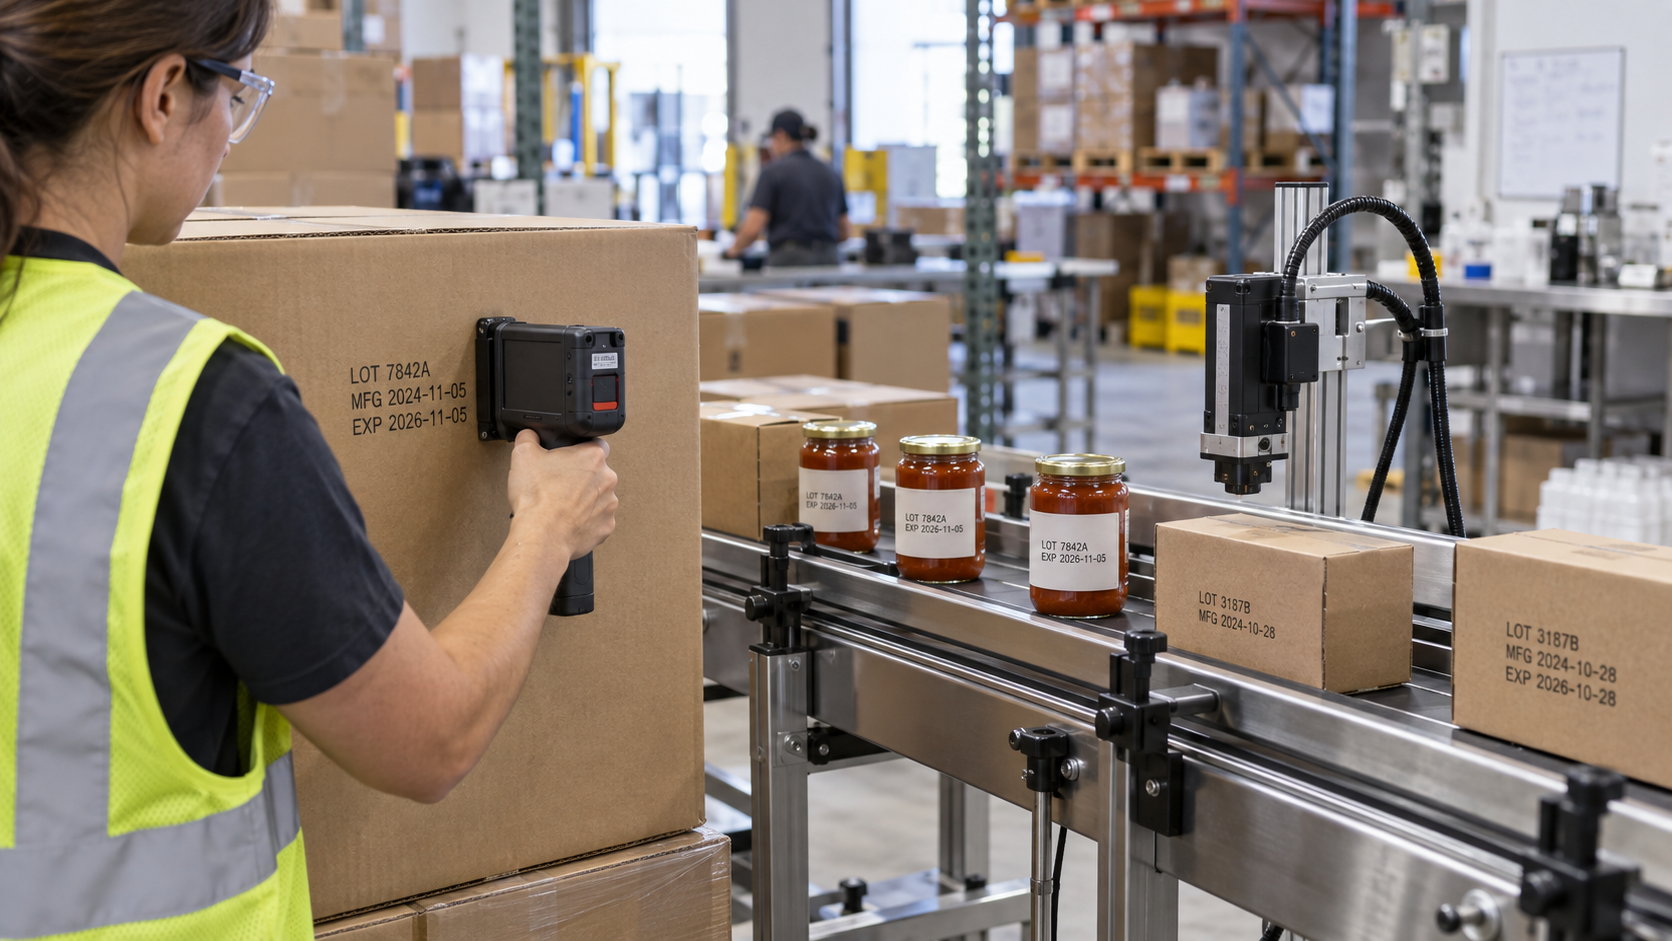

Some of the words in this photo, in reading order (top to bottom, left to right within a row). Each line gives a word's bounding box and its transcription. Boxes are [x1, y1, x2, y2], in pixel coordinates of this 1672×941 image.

[350, 365, 380, 384] LOT
[386, 361, 430, 380] 7842A
[351, 391, 382, 410] MFG
[388, 382, 467, 406] 2024-11-05
[352, 416, 382, 436] EXP
[388, 406, 467, 431] 2026-11-05
[806, 491, 818, 500] LOT
[905, 513, 919, 522] LOT
[922, 514, 946, 523] 7842A
[905, 523, 919, 532] EXP
[1041, 540, 1057, 550] LOT
[1060, 542, 1088, 552] 7842A
[1041, 552, 1056, 562] EXP
[1060, 554, 1106, 564] 2026-11-05
[1199, 591, 1217, 606] LOT
[1221, 596, 1250, 614] 3187B
[1199, 609, 1218, 625] MFG
[1221, 614, 1276, 639] 2024-10-28
[1506, 621, 1532, 640] LOT
[1537, 628, 1579, 651] 3187B
[1506, 644, 1532, 664] MFG
[1537, 651, 1617, 684] 2024-10-28
[1506, 666, 1532, 685] EXP
[1536, 674, 1616, 707] 2026-10-28
